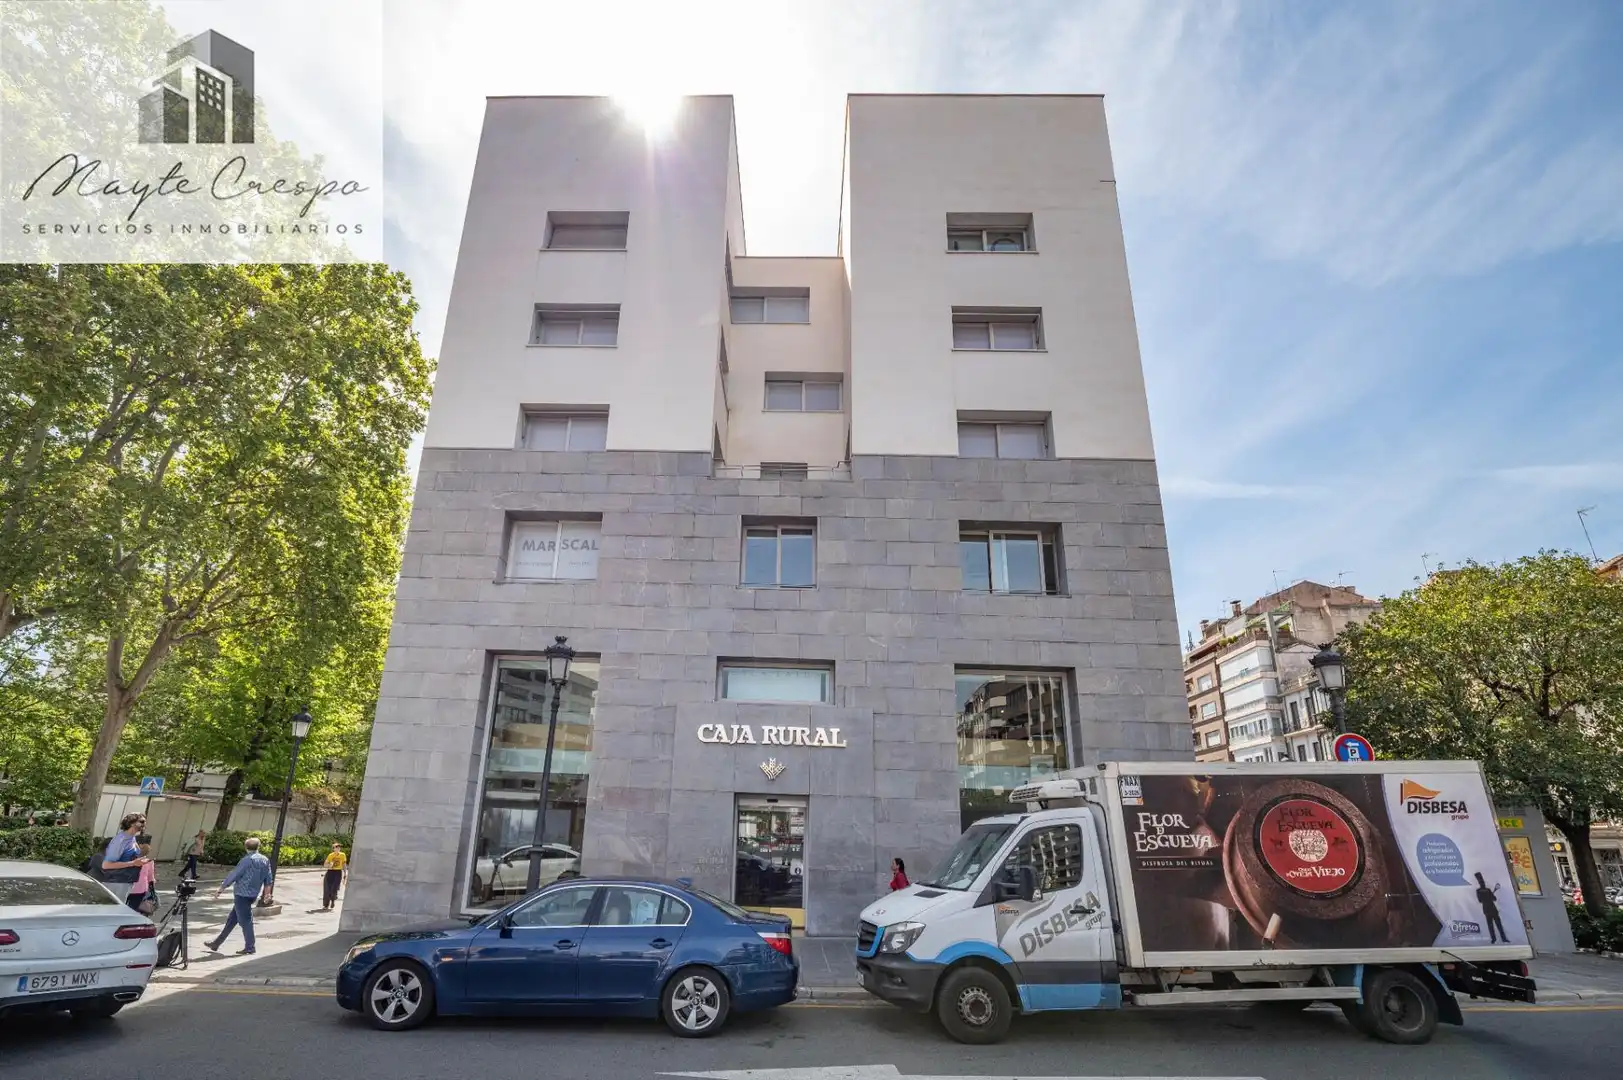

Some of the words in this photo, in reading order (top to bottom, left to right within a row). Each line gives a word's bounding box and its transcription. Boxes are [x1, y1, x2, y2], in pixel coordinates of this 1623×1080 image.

[522, 539, 600, 551] MARSCAL
[697, 723, 757, 744] CAJA
[761, 725, 848, 748] RURAL
[1350, 749, 1357, 757] P
[1406, 801, 1469, 814] DISBESA
[1137, 812, 1190, 832] FLOR
[1277, 820, 1336, 832] ESGUEVA
[1133, 832, 1219, 852] ESGUEVA
[1311, 866, 1346, 878] VIEJO
[1019, 891, 1101, 958] DISBESA
[1085, 911, 1107, 930] grupo
[31, 975, 66, 988] 6791
[72, 972, 97, 985] MNX
